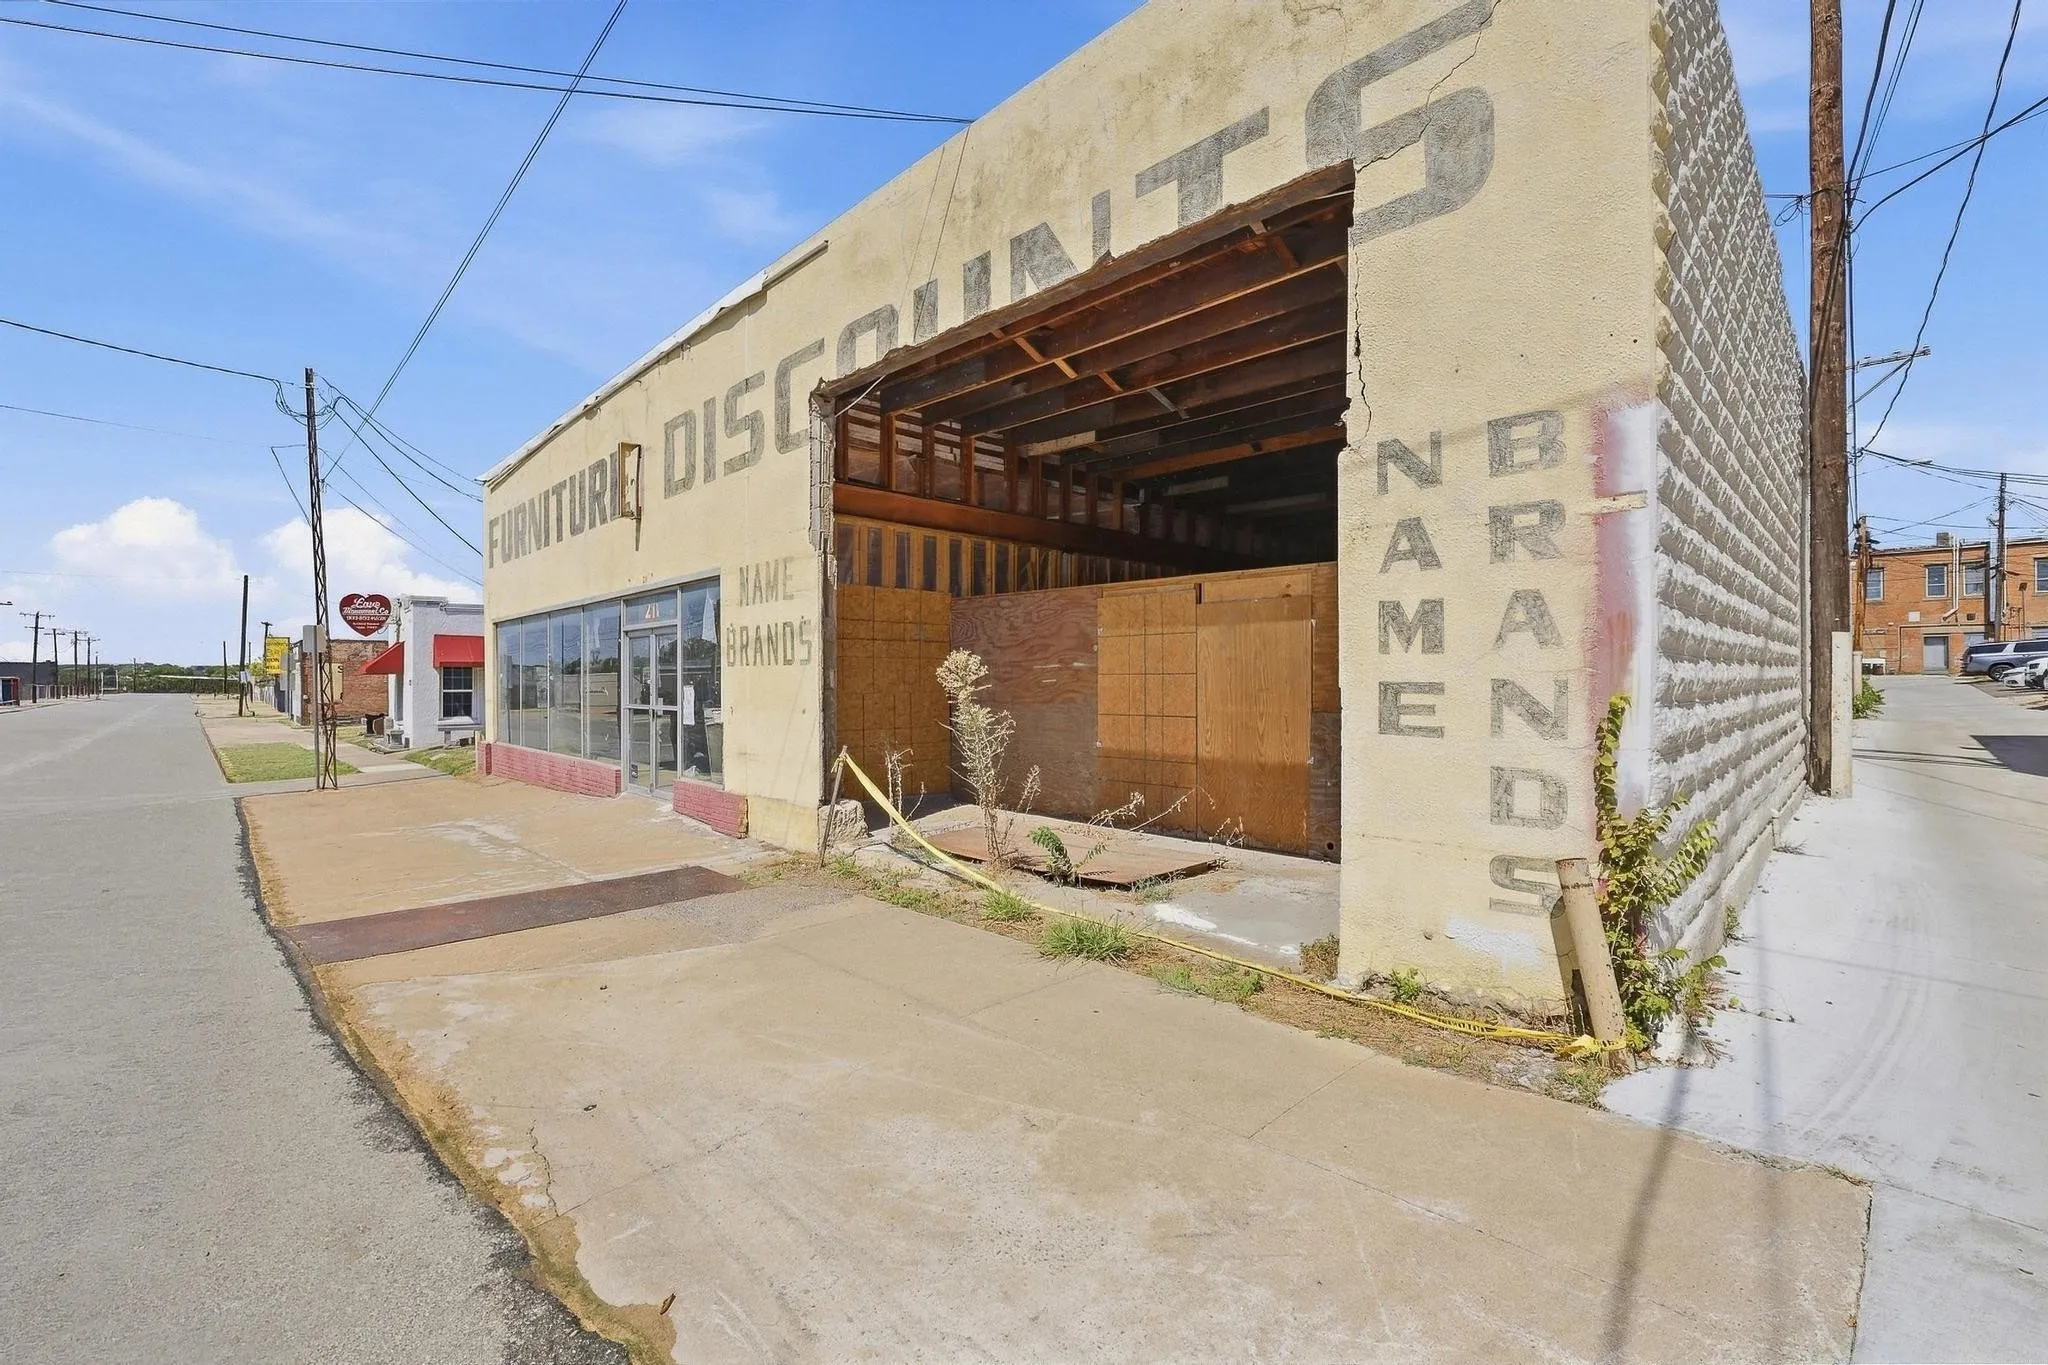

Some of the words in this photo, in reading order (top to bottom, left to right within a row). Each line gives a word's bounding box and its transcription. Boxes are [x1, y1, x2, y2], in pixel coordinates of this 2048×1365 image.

[726, 616, 813, 668] BRANDS
[738, 556, 795, 607] NAME
[1376, 430, 1446, 739] NAME
[1487, 409, 1569, 917] BRANDS
